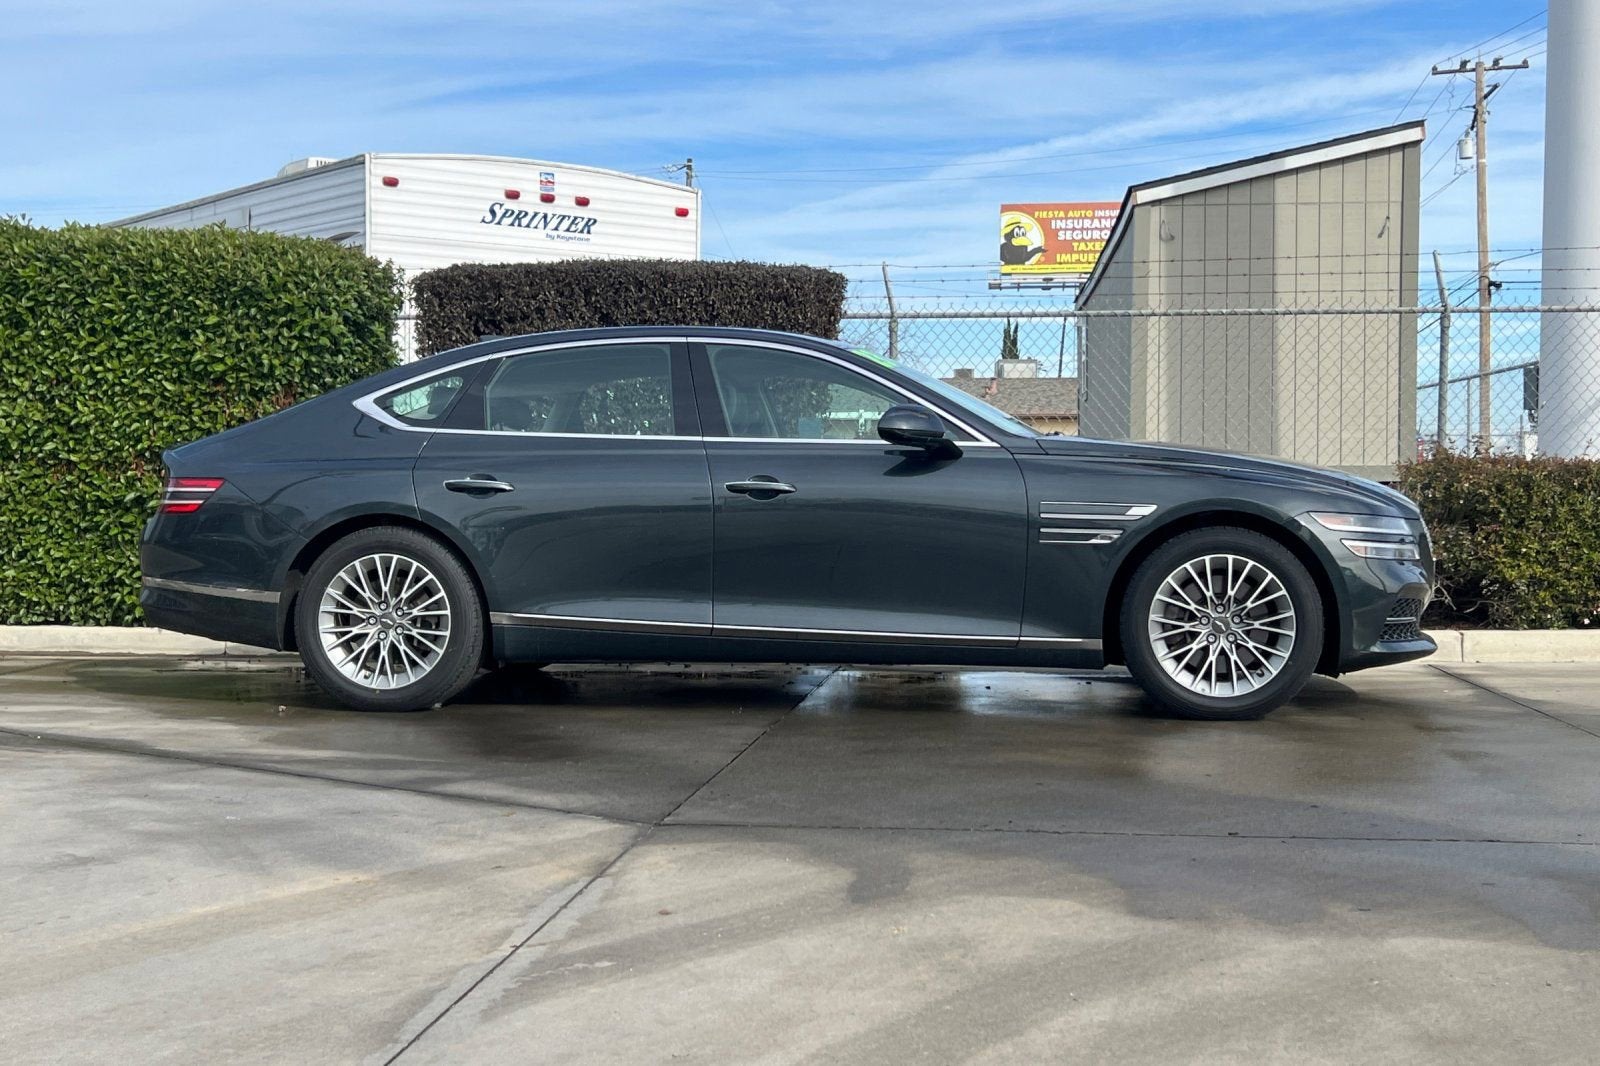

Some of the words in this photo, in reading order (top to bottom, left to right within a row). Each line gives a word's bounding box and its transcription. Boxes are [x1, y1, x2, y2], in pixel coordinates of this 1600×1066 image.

[1034, 210, 1065, 218] FIESTA
[1067, 210, 1093, 218] AUTO
[545, 233, 555, 241] by
[557, 234, 591, 242] Keystone
